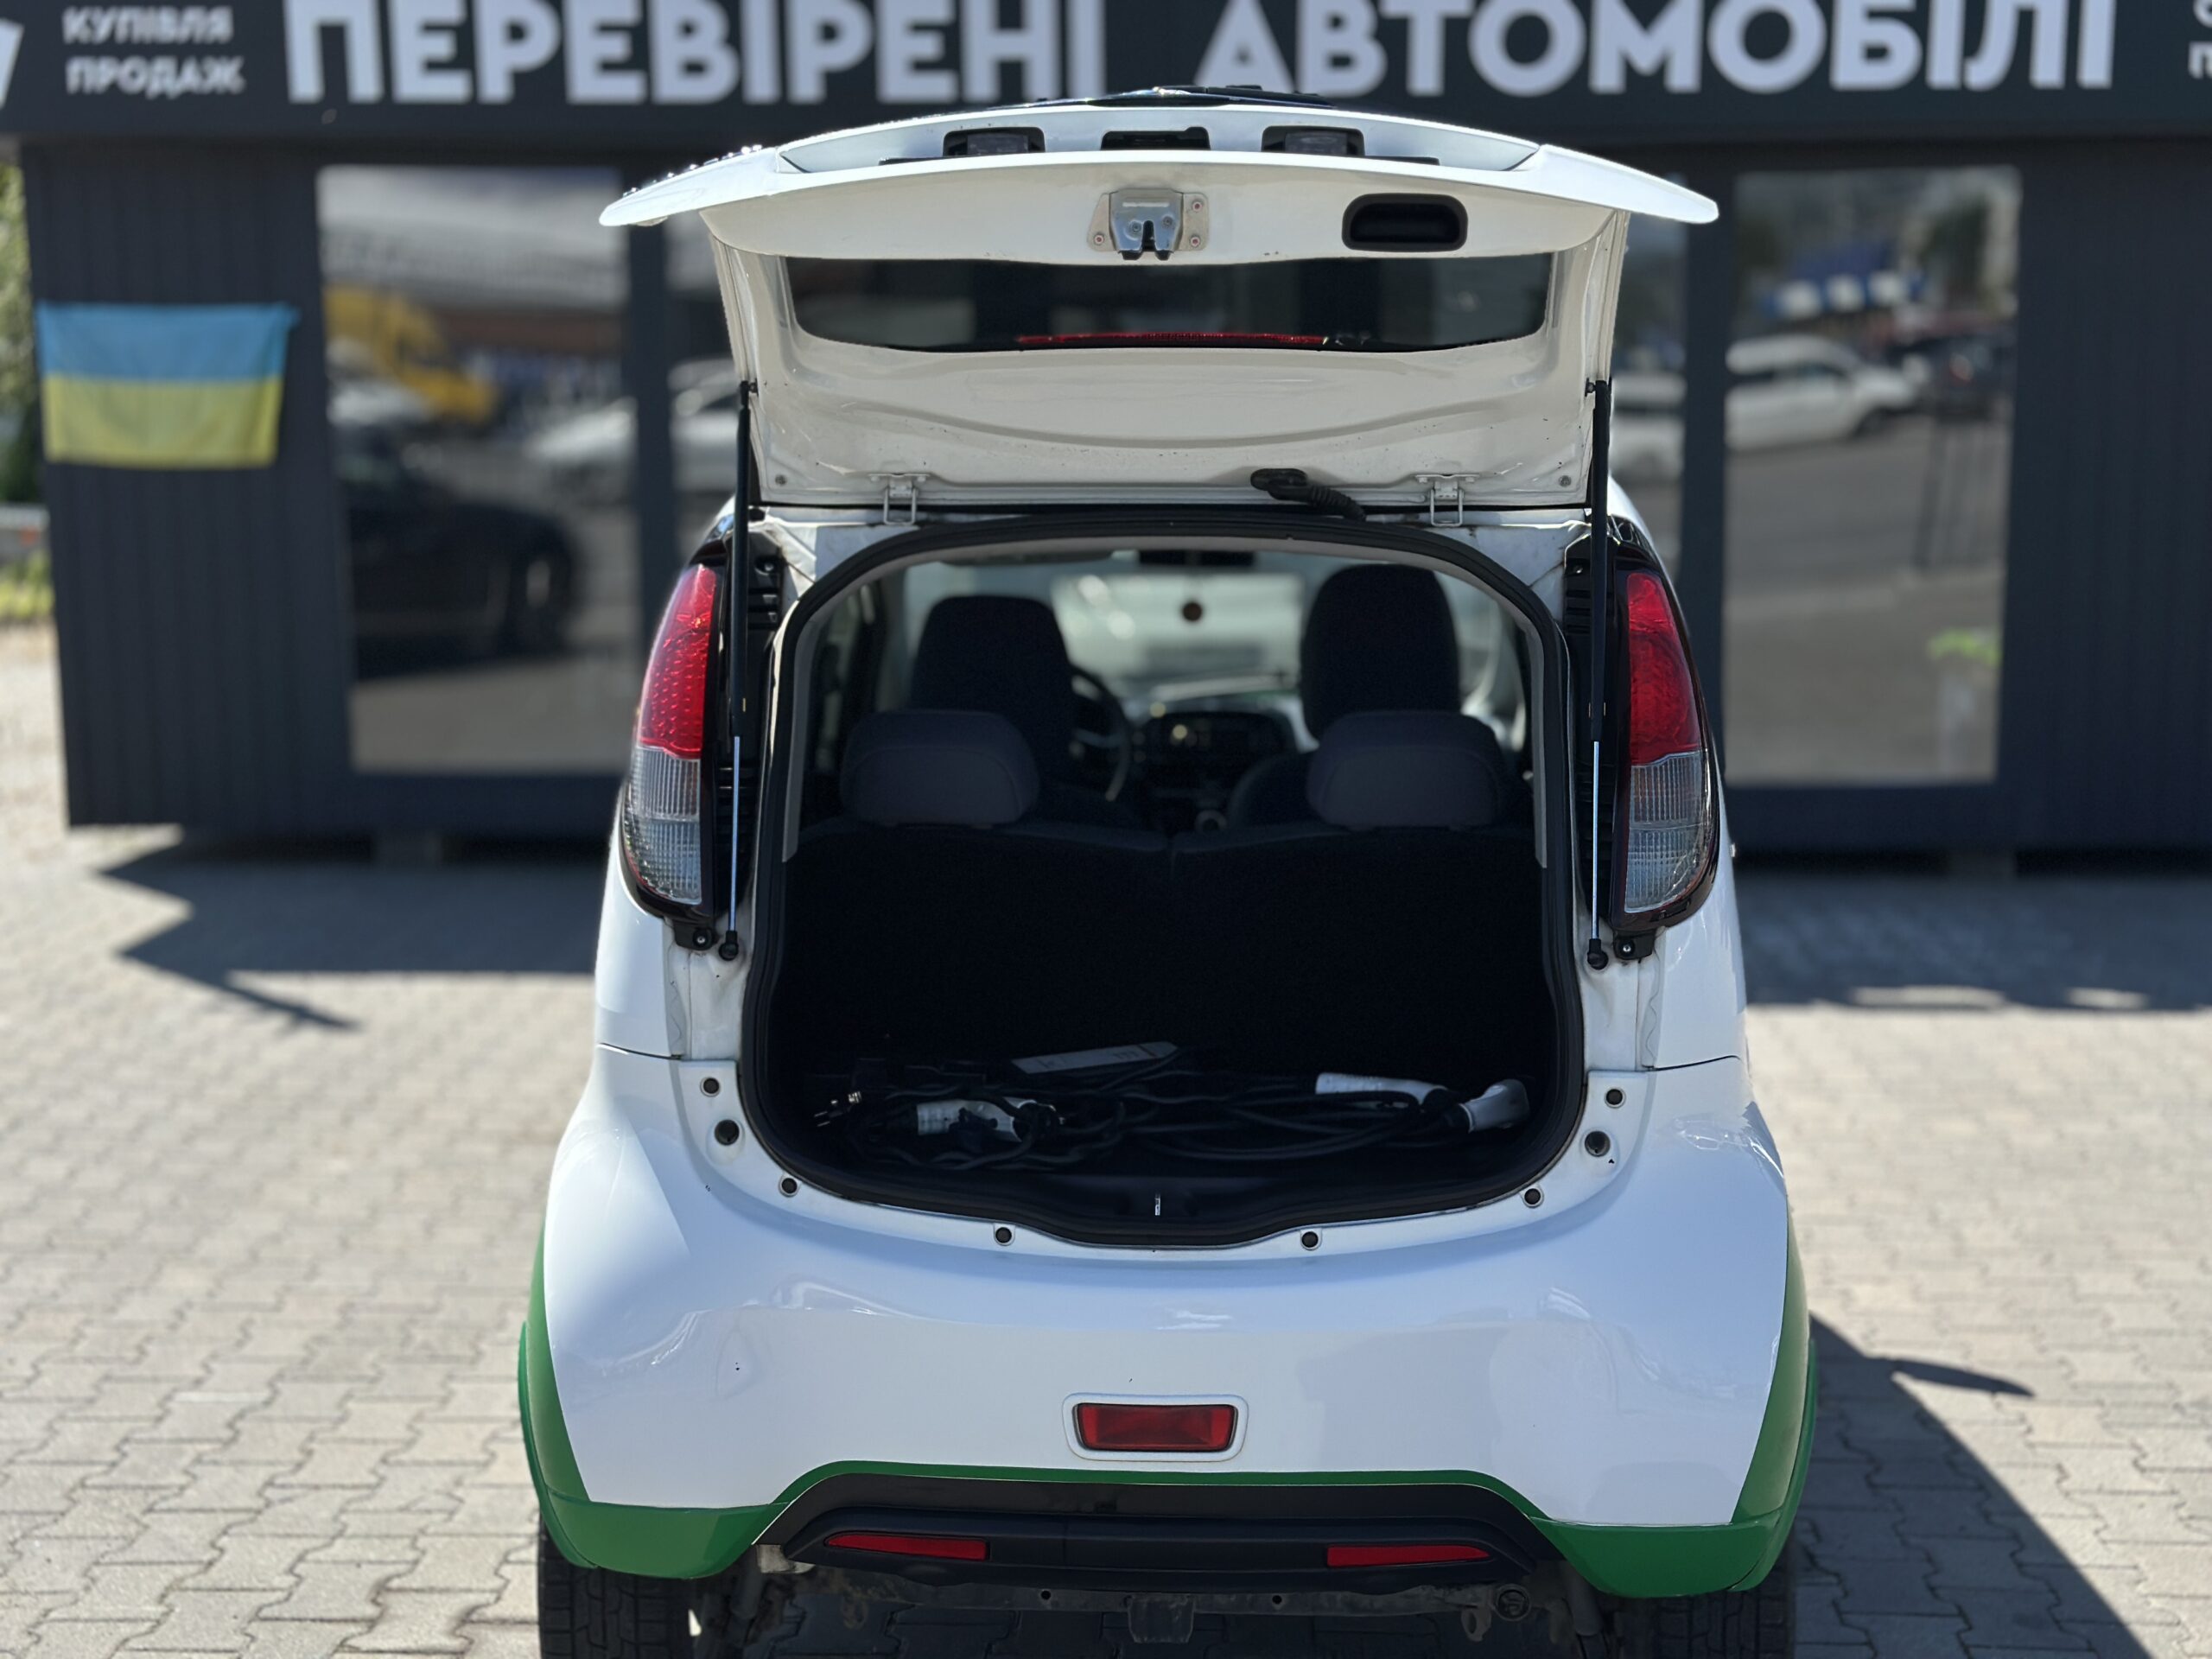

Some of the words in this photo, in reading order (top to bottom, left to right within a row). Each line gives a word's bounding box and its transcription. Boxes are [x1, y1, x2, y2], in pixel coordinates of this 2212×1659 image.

[63, 6, 232, 43] КУПІВЛЯ
[284, 0, 1103, 103] ПЕРЕВІРЕНІ
[1194, 0, 2116, 97] АВТОМОБІЛІ
[67, 55, 245, 99] ПРОДАЖ
